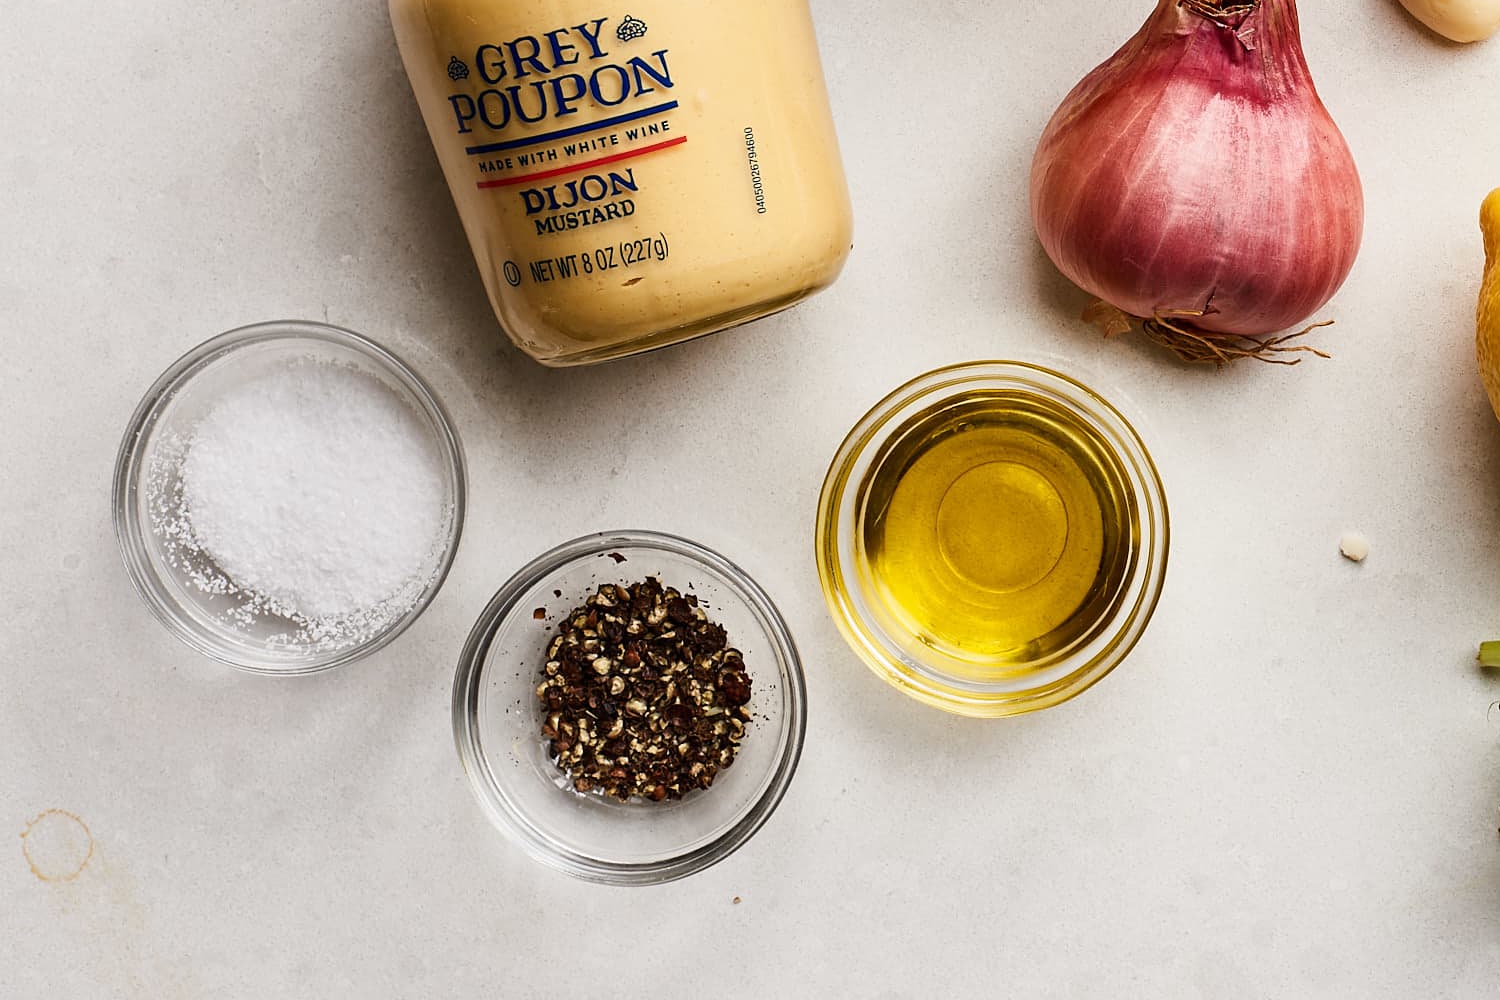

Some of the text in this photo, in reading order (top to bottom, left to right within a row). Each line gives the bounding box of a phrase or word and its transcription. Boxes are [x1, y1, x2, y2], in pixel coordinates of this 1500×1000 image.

[475, 17, 609, 85] GREY
[448, 49, 674, 134] POUPON
[478, 120, 672, 174] MADE WITH WHITE WINE
[744, 127, 767, 214] 04050026794600
[519, 168, 640, 217] DIJON
[534, 199, 636, 236] MUSTARD
[530, 259, 554, 284] NET
[554, 255, 578, 279] WT
[581, 252, 593, 275] 8
[595, 246, 617, 271] OZ
[620, 232, 670, 268] (227g)
